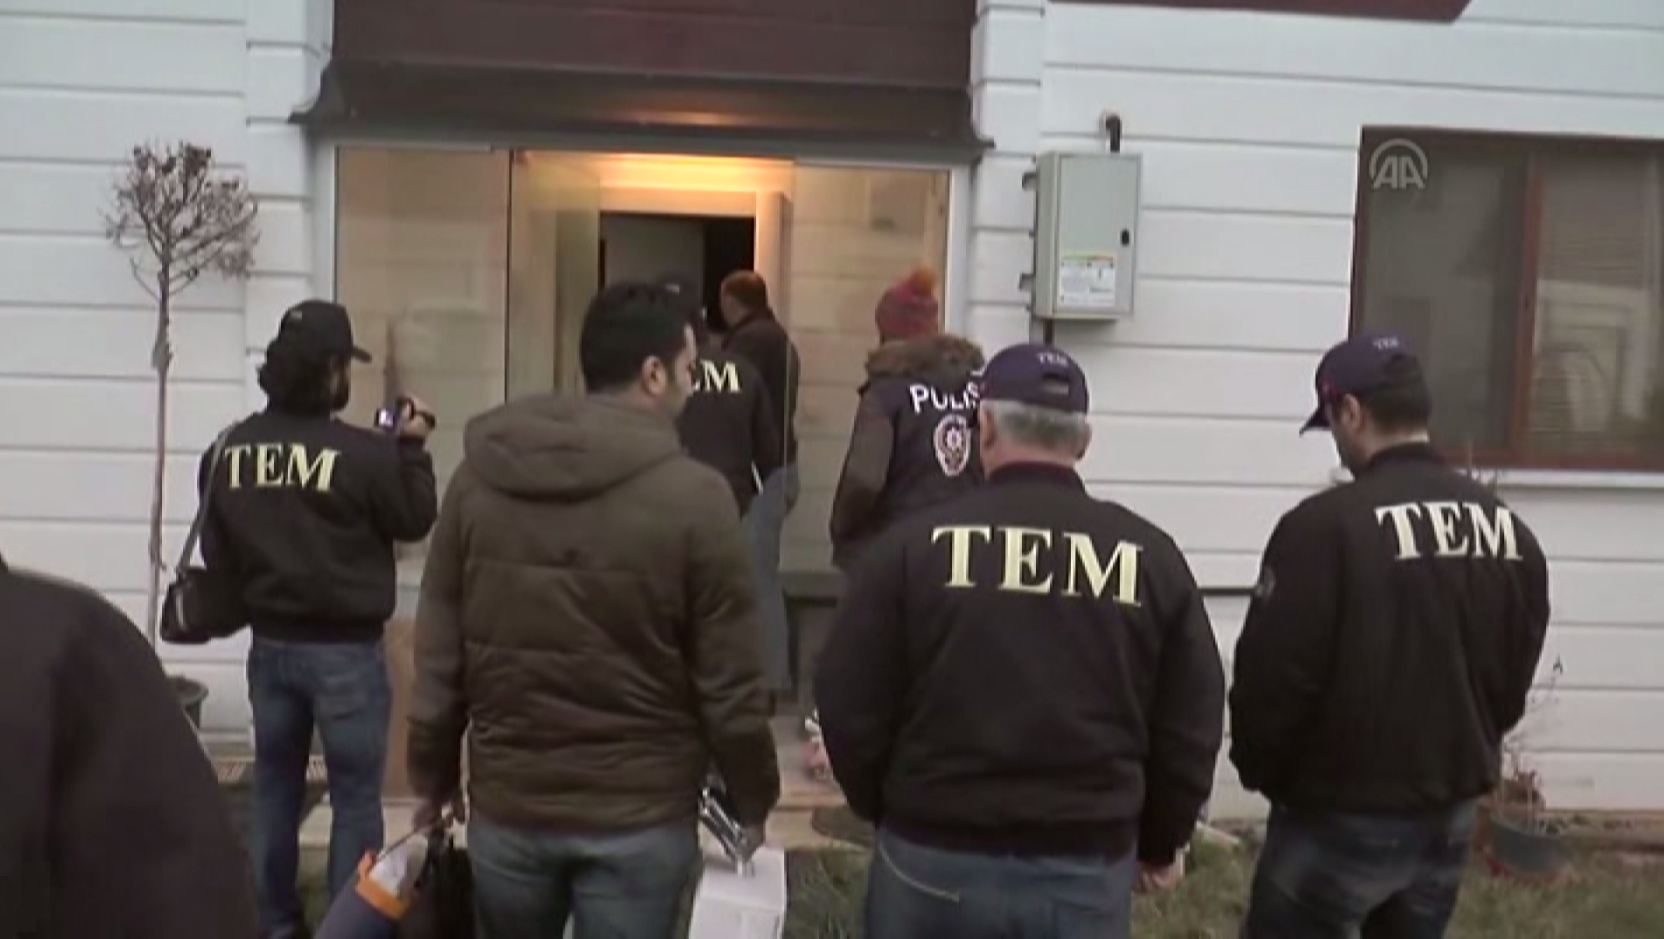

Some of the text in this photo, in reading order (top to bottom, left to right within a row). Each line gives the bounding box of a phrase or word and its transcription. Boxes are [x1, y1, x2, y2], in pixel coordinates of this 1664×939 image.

[224, 442, 340, 491] TEM
[1374, 501, 1524, 560] TEM
[931, 524, 1144, 607] TEM
